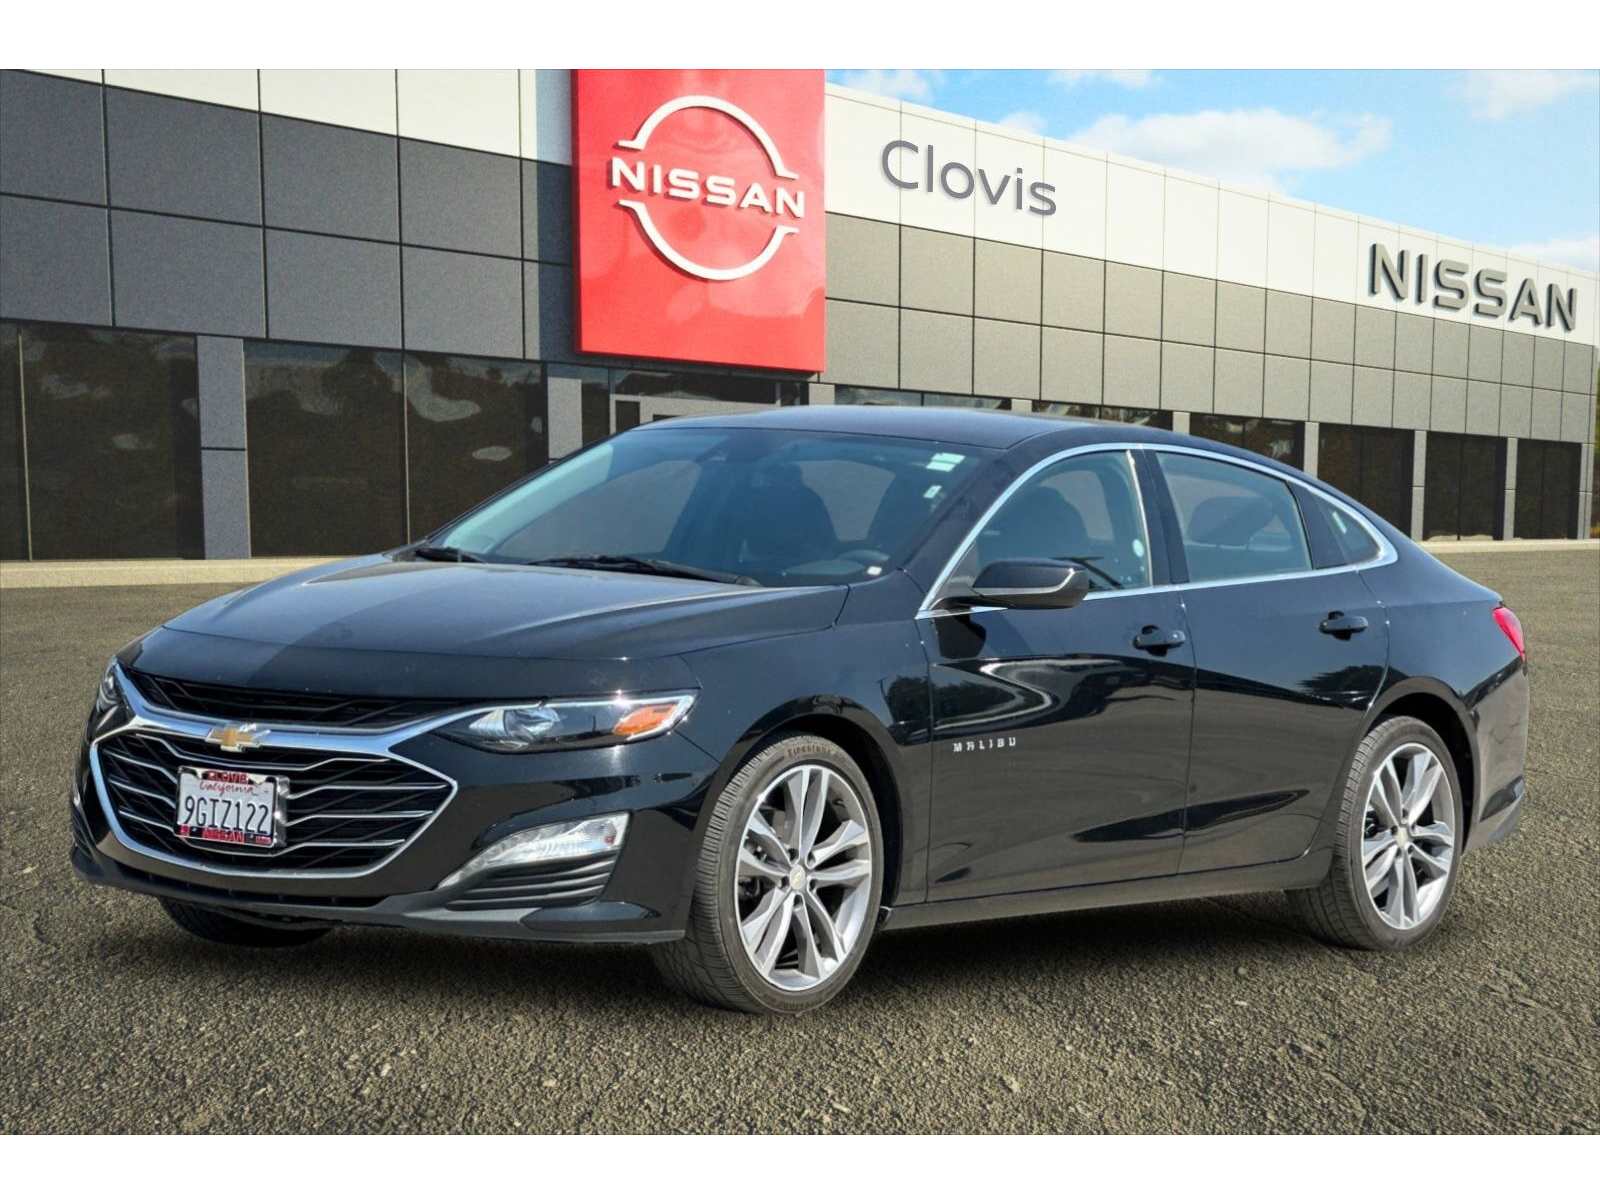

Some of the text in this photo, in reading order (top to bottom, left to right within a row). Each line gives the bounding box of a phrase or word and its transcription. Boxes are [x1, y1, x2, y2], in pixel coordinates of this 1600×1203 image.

[611, 157, 805, 218] NISSAN
[881, 140, 1057, 215] Clovis
[1369, 243, 1578, 331] NISSAN
[953, 737, 1016, 752] MALIBU
[185, 795, 269, 834] 9GIZ122
[200, 782, 254, 797] California
